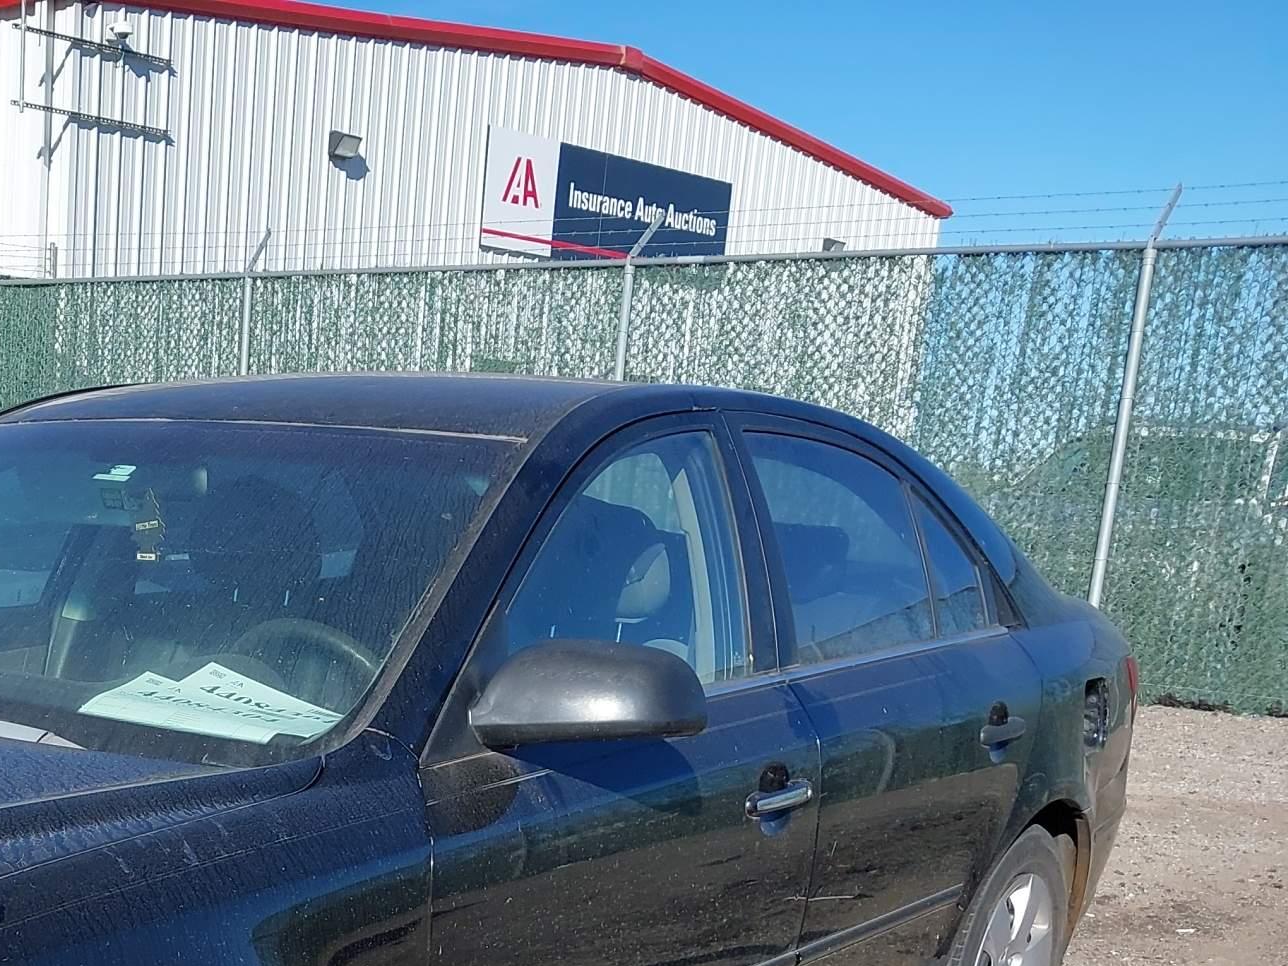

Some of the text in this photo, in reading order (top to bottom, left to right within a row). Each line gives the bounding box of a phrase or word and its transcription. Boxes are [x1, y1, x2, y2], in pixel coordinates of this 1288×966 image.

[569, 182, 717, 237] Insurance Auto Auctions
